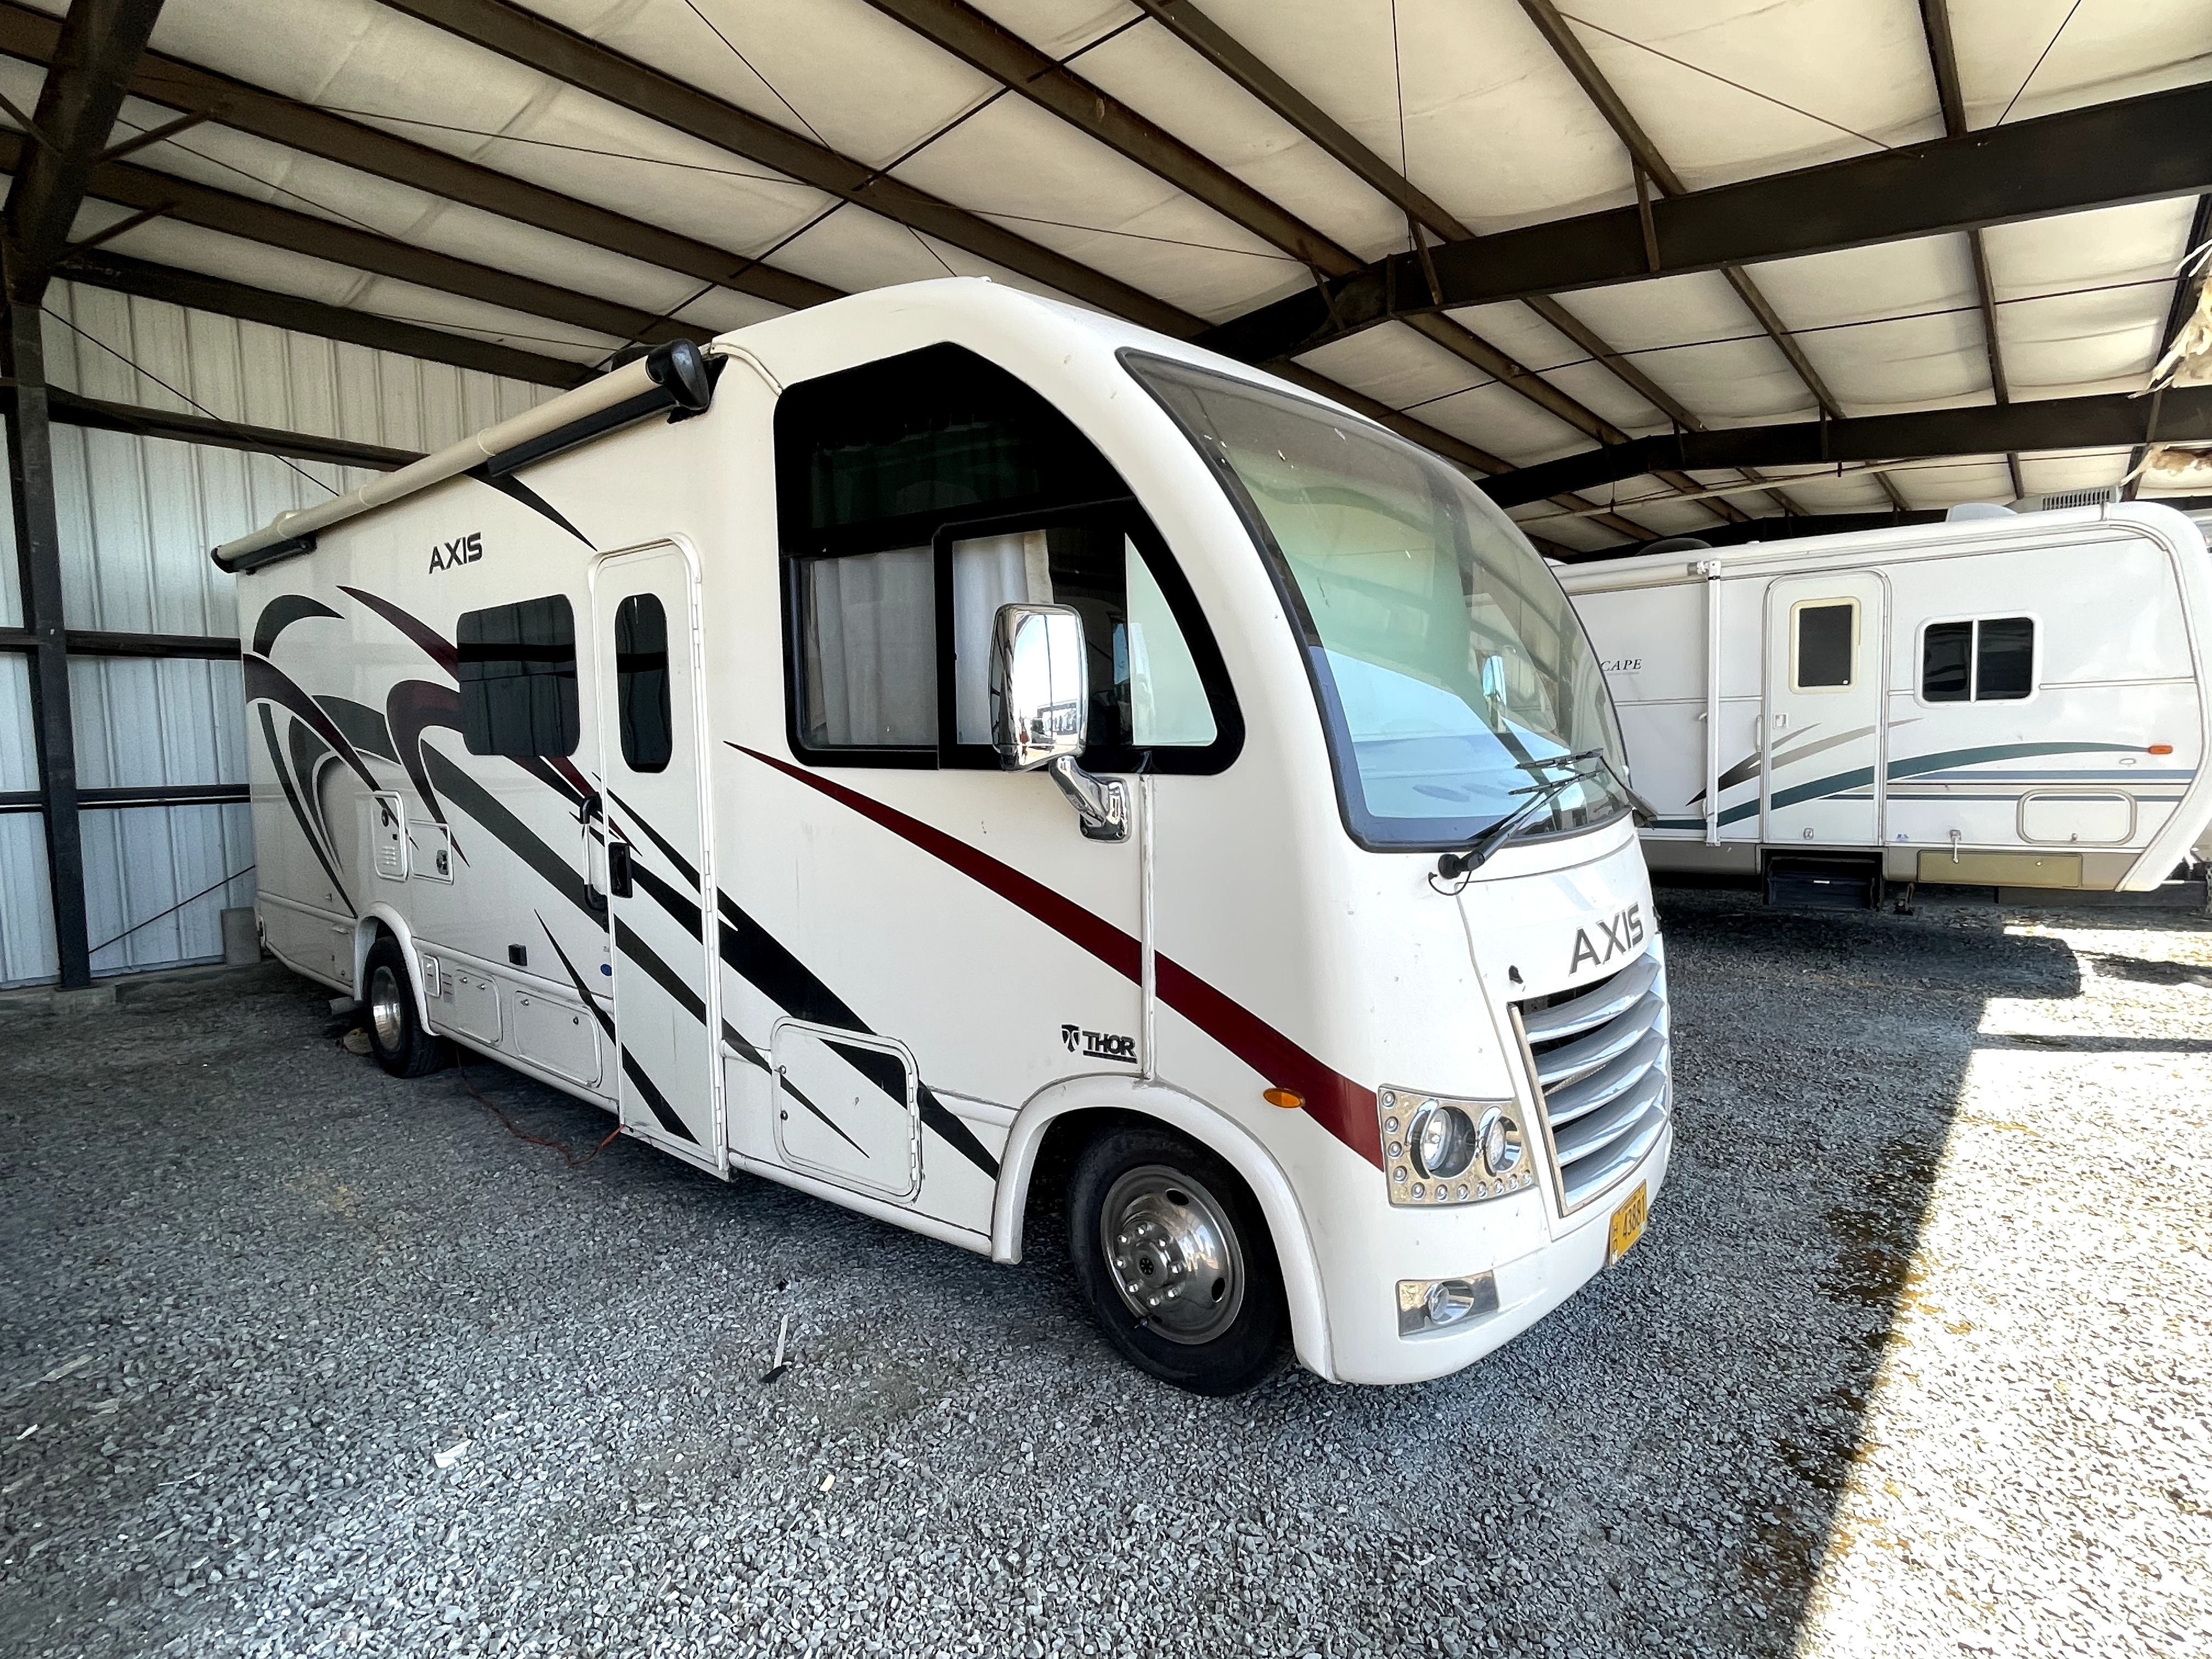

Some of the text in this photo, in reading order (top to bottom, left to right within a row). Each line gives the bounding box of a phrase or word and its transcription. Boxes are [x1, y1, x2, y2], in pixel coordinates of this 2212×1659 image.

[428, 532, 483, 574] AXIS
[1568, 901, 1644, 978] AXIS
[1082, 1030, 1137, 1058] THOR
